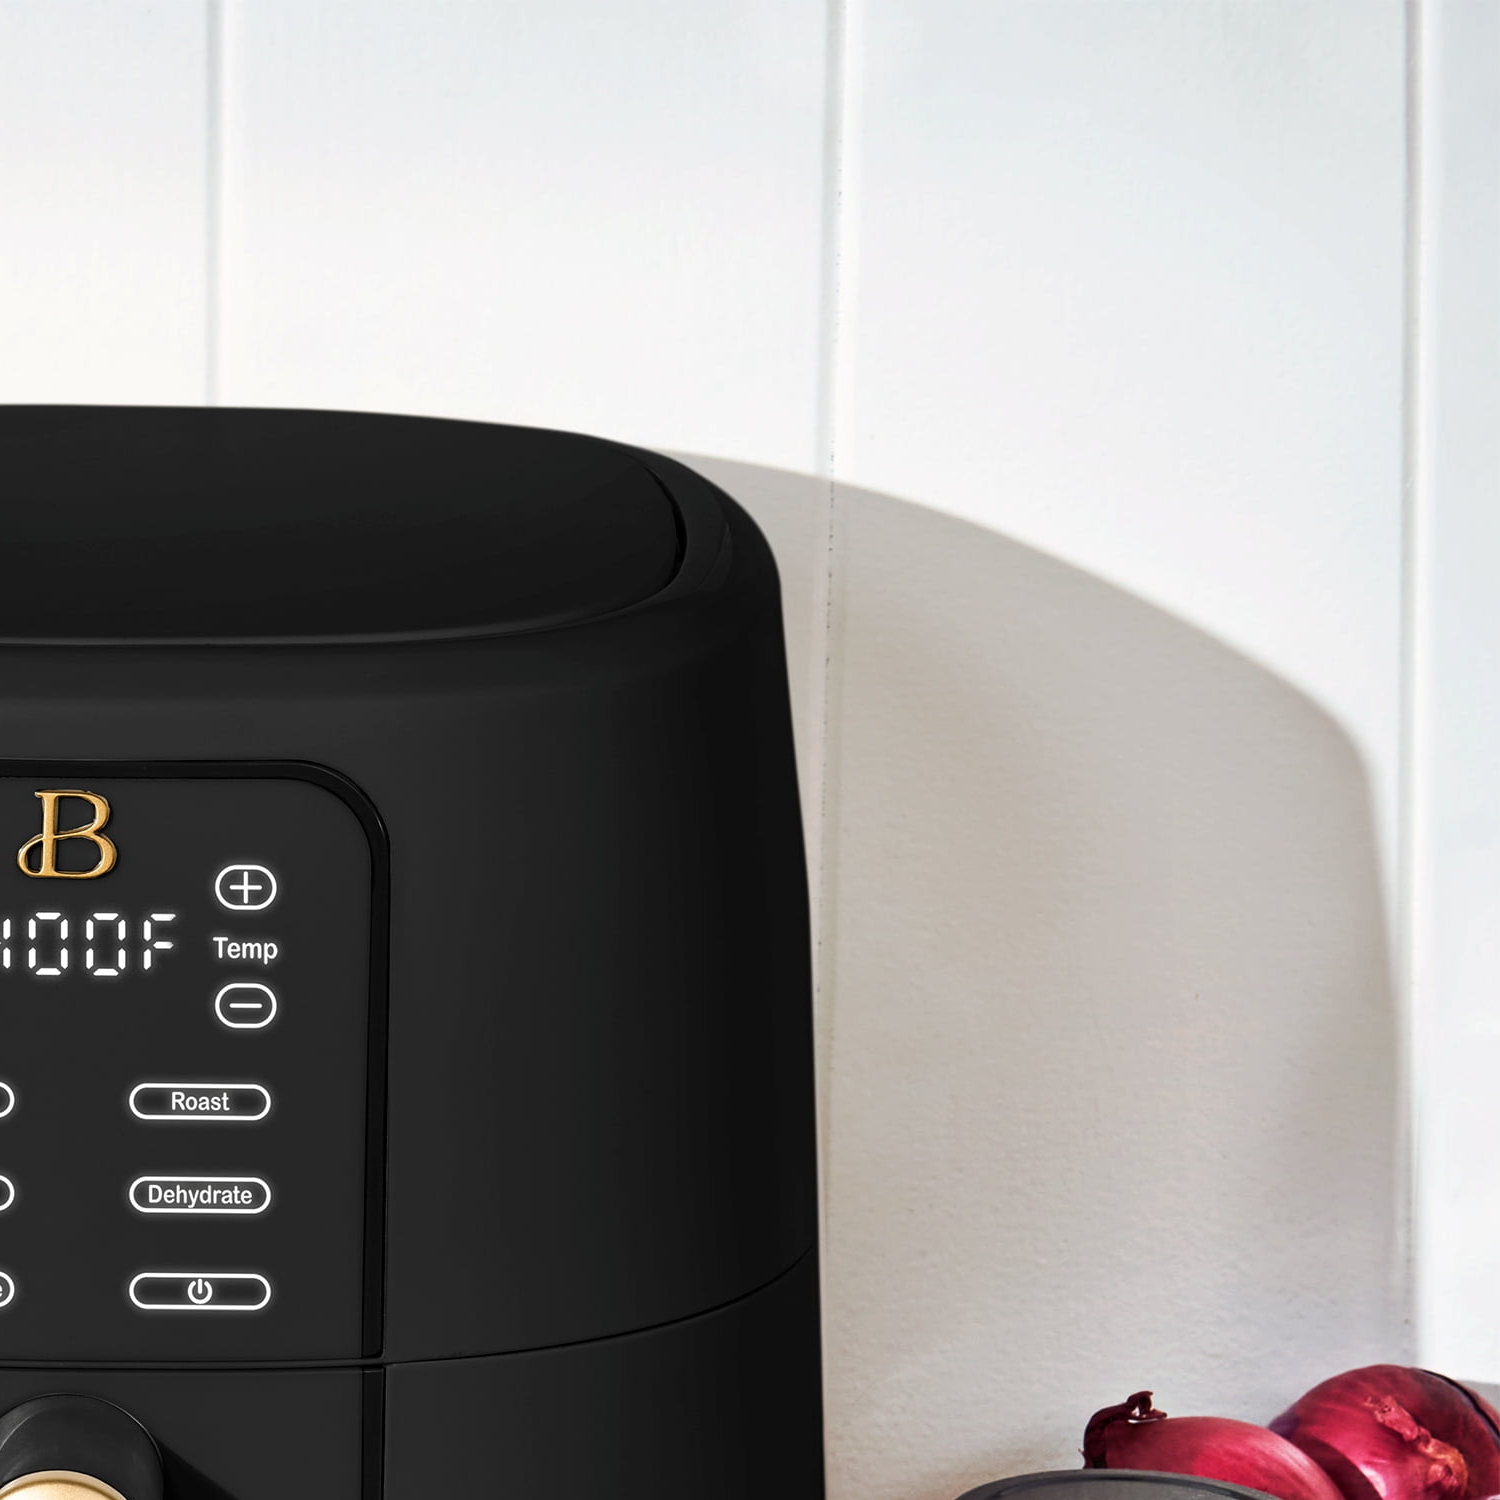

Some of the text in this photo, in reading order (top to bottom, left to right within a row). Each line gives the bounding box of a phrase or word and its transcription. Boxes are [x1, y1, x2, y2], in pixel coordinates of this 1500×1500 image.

[17, 789, 117, 879] B
[213, 937, 278, 964] Temp
[171, 1092, 230, 1111] Roast
[148, 1184, 253, 1207] Dehydrate
